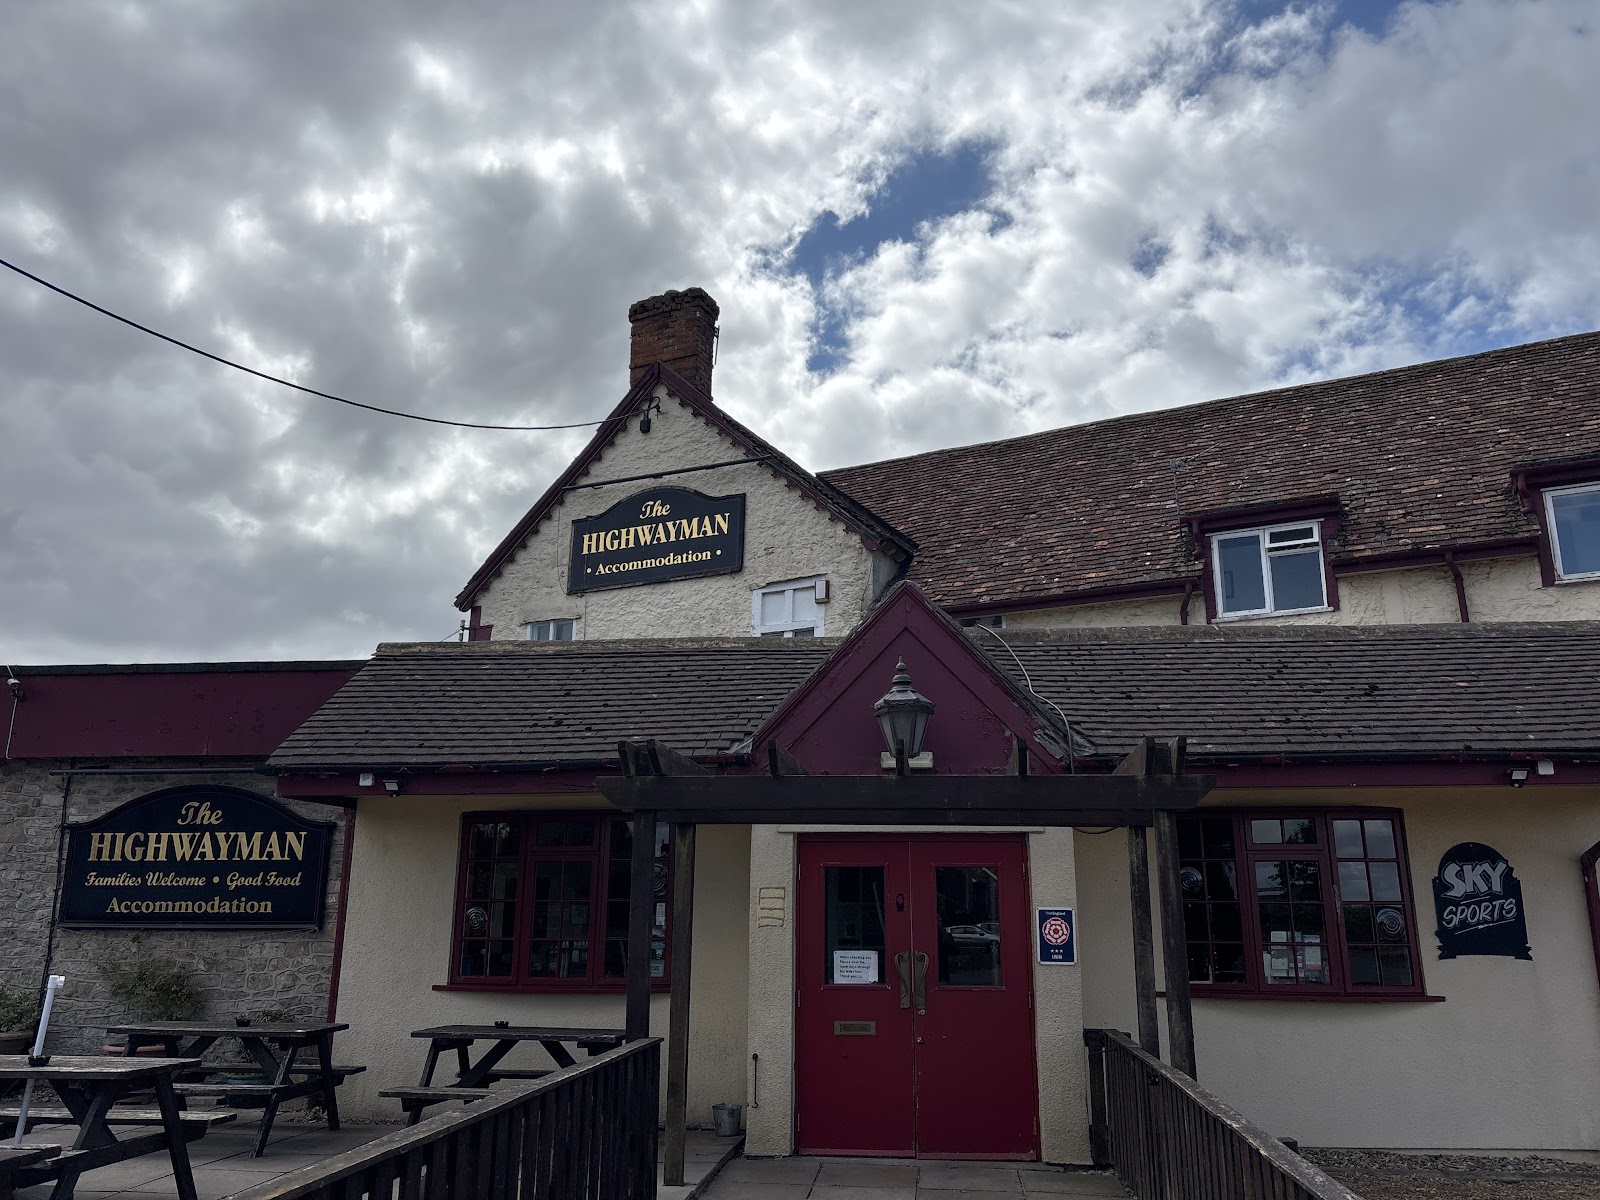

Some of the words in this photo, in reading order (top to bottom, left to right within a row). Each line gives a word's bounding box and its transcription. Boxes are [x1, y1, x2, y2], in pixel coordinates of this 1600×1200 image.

[639, 499, 671, 520] The
[581, 512, 731, 556] HIGHWAYMAN
[595, 550, 712, 575] Accommodation
[177, 801, 223, 826] The
[87, 831, 308, 862] HIGHWAYMAN
[84, 871, 142, 887] Families
[145, 871, 206, 887] Welcome
[226, 871, 263, 890] Good
[264, 871, 302, 887] Food
[1441, 860, 1509, 899] SKY
[105, 895, 273, 914] Accommodation
[1442, 898, 1518, 929] SPORTS
